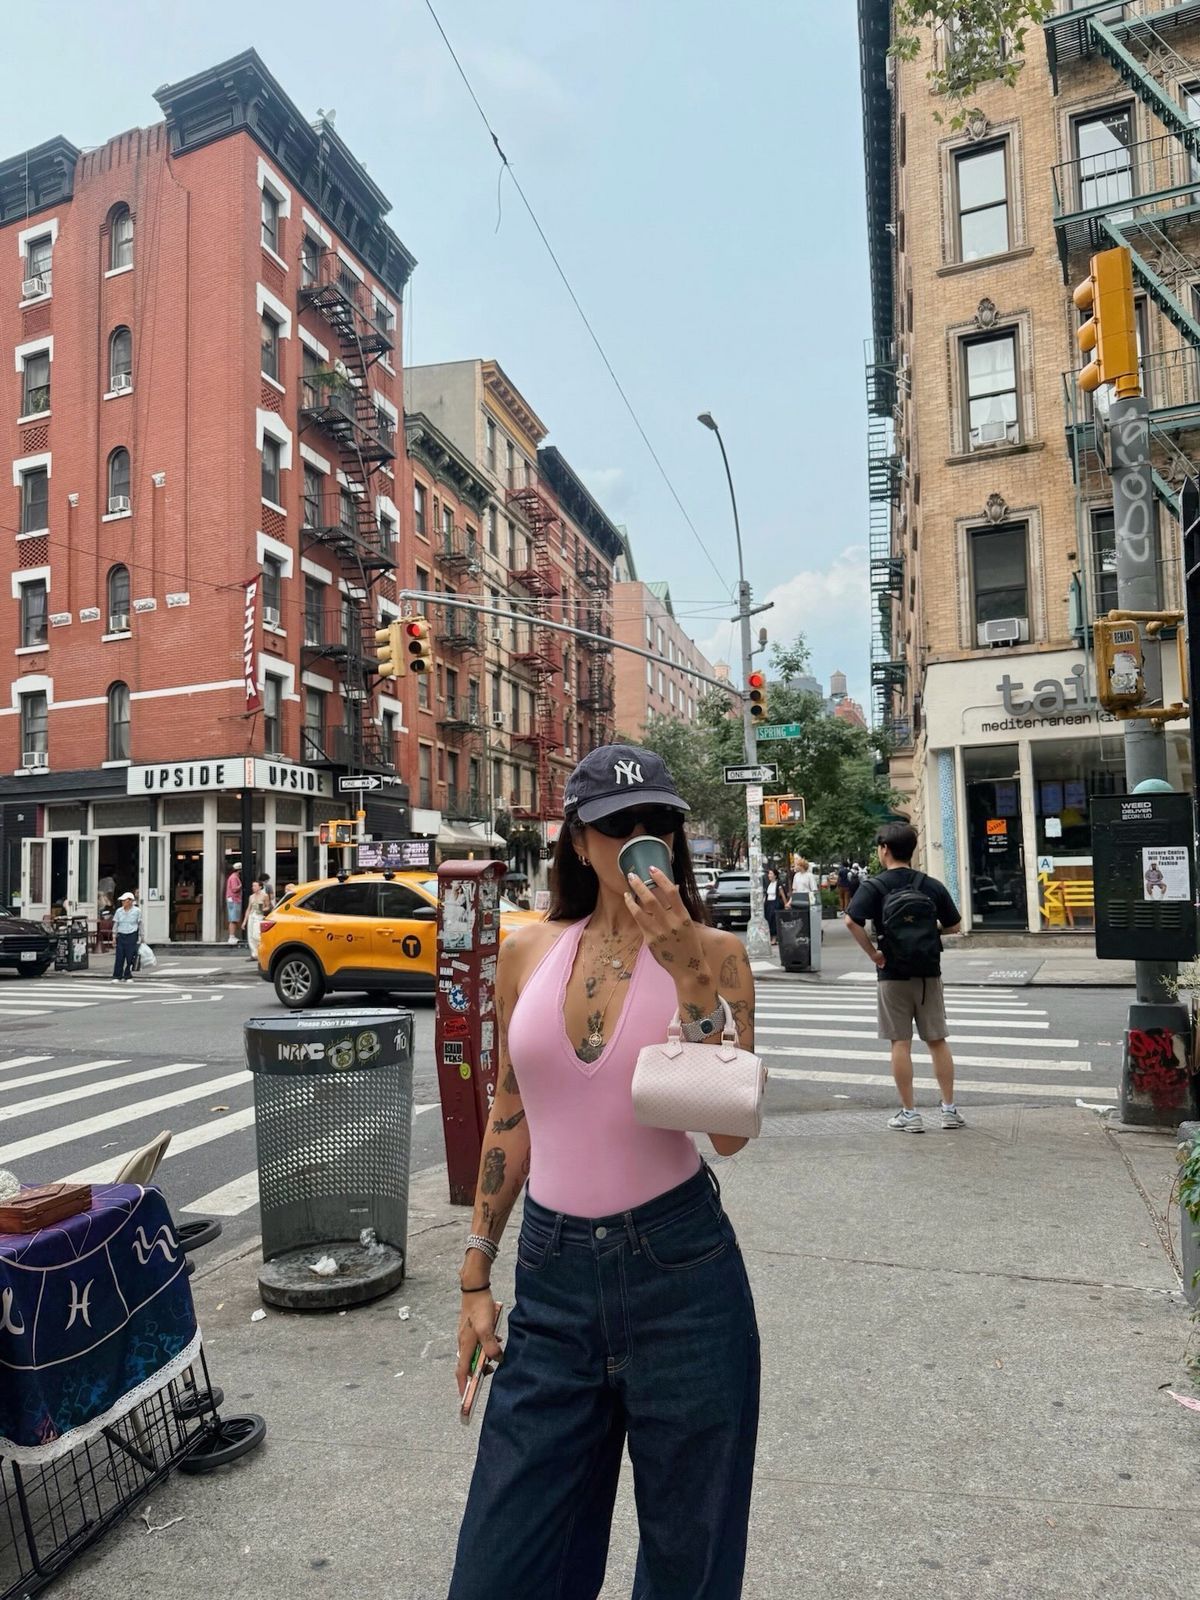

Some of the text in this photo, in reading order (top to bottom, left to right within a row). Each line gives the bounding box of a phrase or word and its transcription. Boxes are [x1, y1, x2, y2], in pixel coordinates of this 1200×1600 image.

[244, 583, 257, 700] PIZZA
[981, 714, 1092, 732] mediterranean
[759, 727, 786, 738] SPRING
[144, 764, 225, 789] UPSIDE
[269, 765, 324, 792] UPSIDE
[614, 760, 644, 785] NY
[751, 770, 767, 778] WAY
[1041, 859, 1050, 868] A
[150, 888, 157, 897] A
